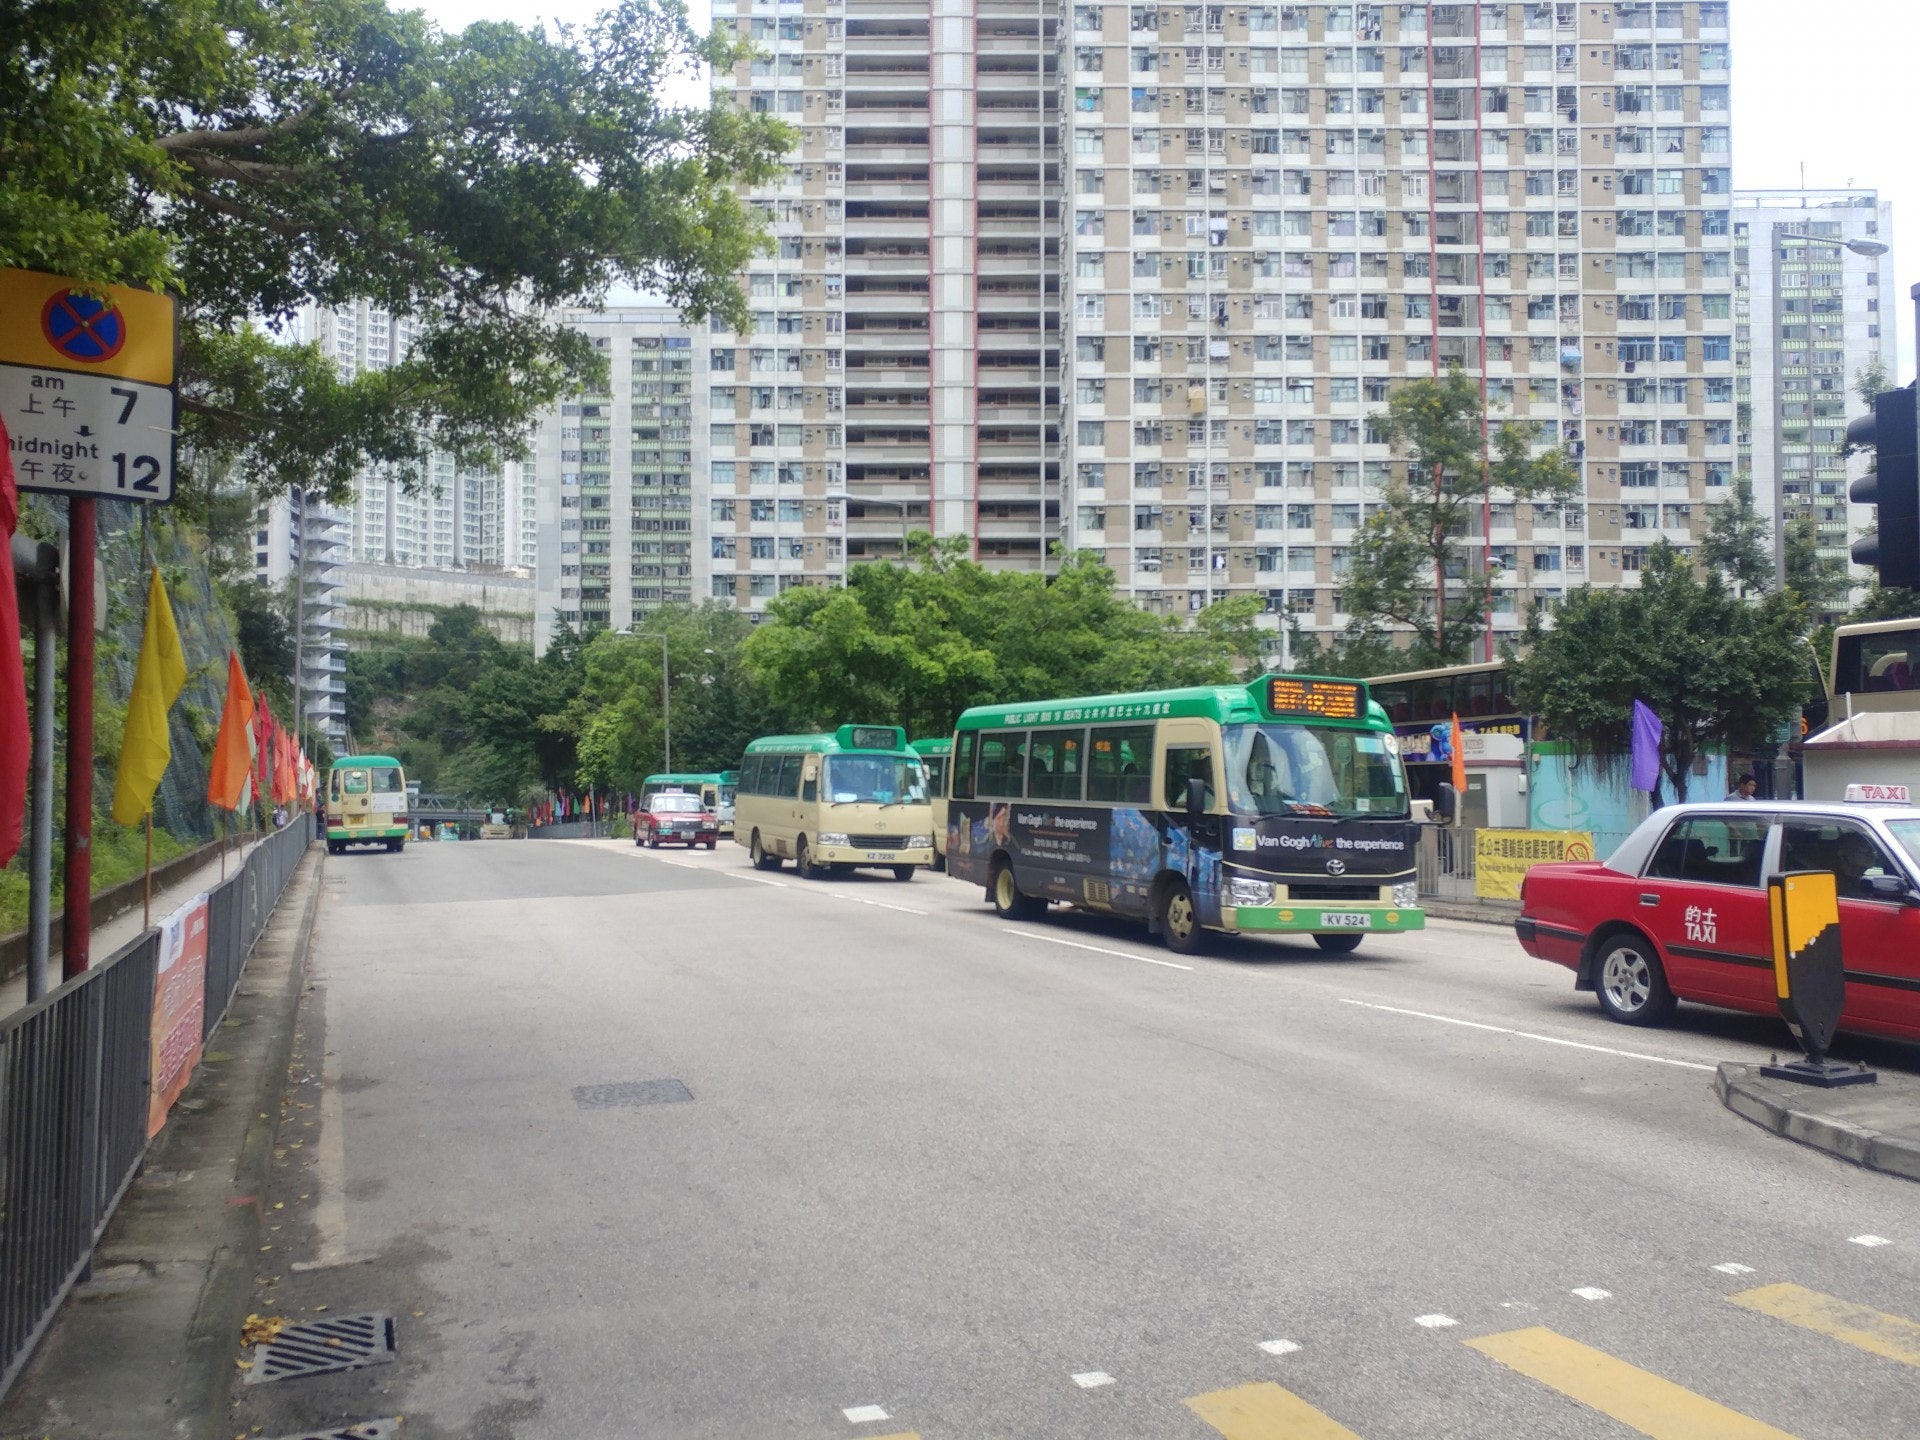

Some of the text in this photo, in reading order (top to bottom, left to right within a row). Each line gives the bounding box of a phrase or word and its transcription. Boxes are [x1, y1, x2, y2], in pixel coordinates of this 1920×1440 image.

[31, 375, 64, 390] am
[20, 393, 76, 418] 上午
[111, 387, 138, 424] 7
[20, 458, 76, 484] 午夜
[112, 452, 161, 493] 12
[1861, 786, 1906, 800] TAXI
[1256, 835, 1279, 847] Van
[1280, 835, 1310, 850] Gogh
[1336, 837, 1353, 849] the
[1354, 838, 1404, 851] experience
[1327, 915, 1365, 926] KV 524
[1685, 905, 1717, 925] 的士
[1684, 922, 1717, 944] TAXI
